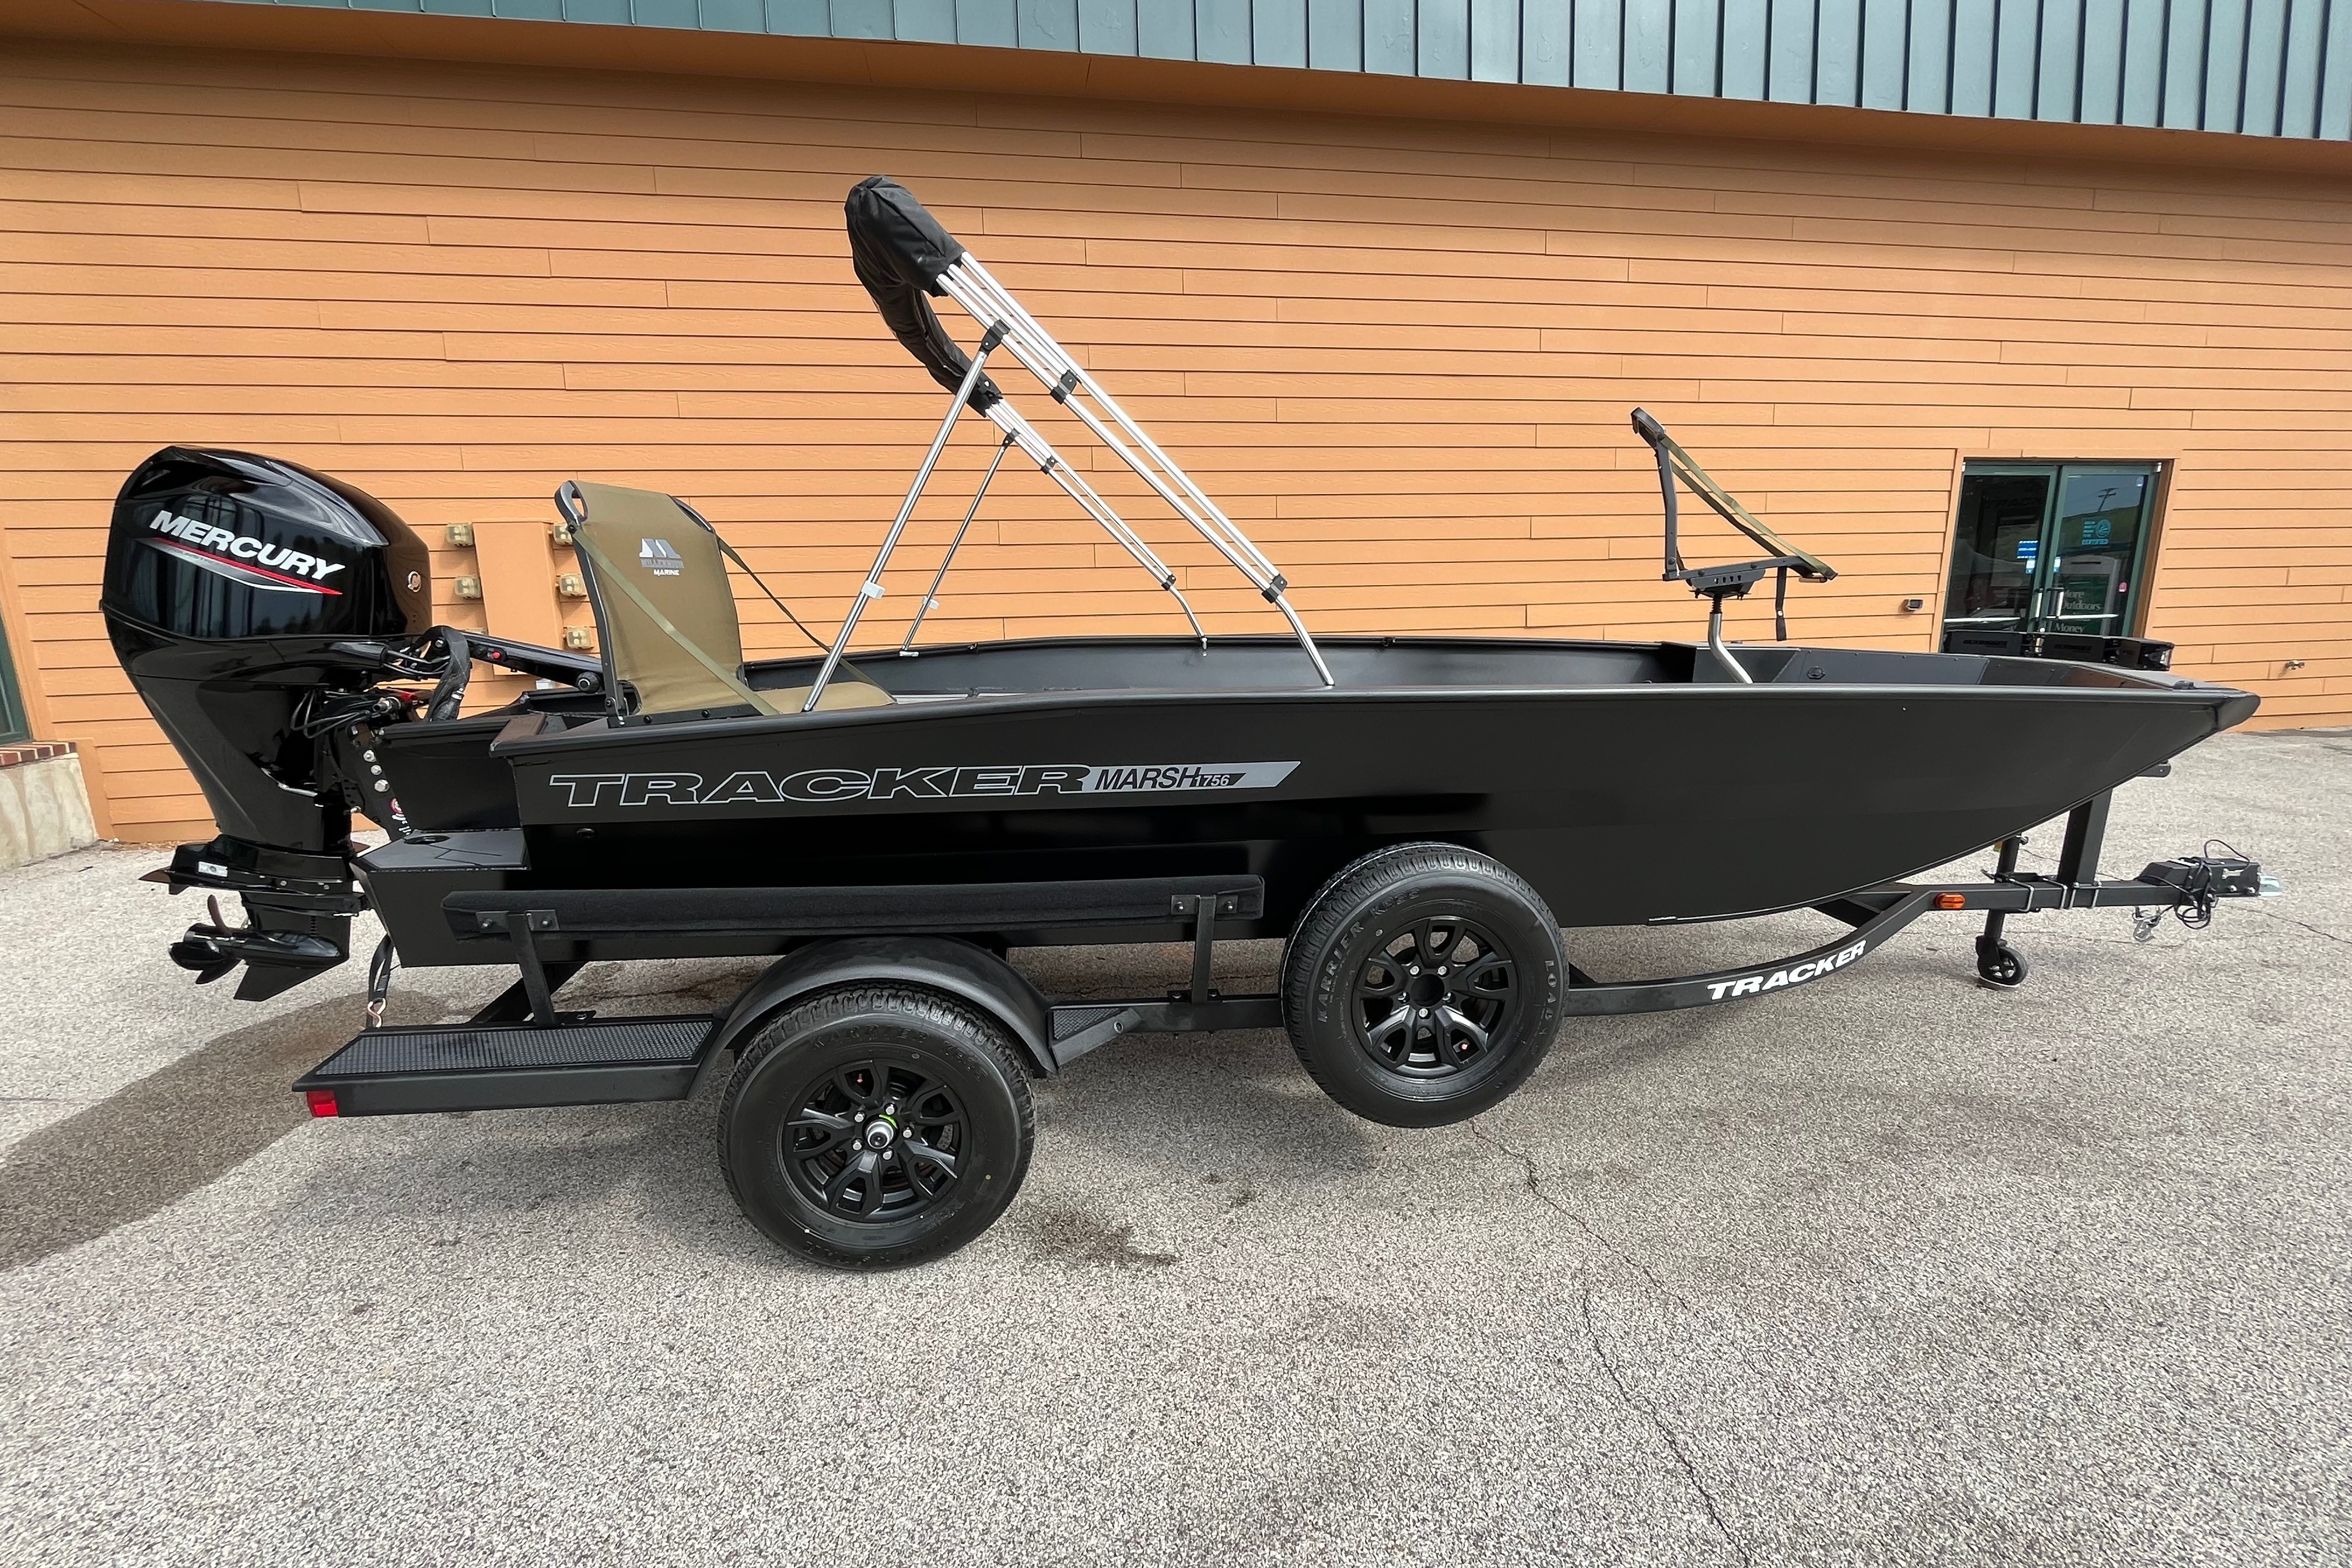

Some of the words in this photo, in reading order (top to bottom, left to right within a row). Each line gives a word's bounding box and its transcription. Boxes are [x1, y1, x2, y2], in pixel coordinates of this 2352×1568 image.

[149, 510, 345, 580] MERCURY
[2056, 622, 2087, 634] Money
[550, 764, 1091, 807] TRACKER
[1094, 766, 1201, 791] MARSH
[1194, 774, 1231, 787] 1756
[1317, 921, 1364, 1023] KARRIER
[1707, 940, 1867, 1001] TRACKER
